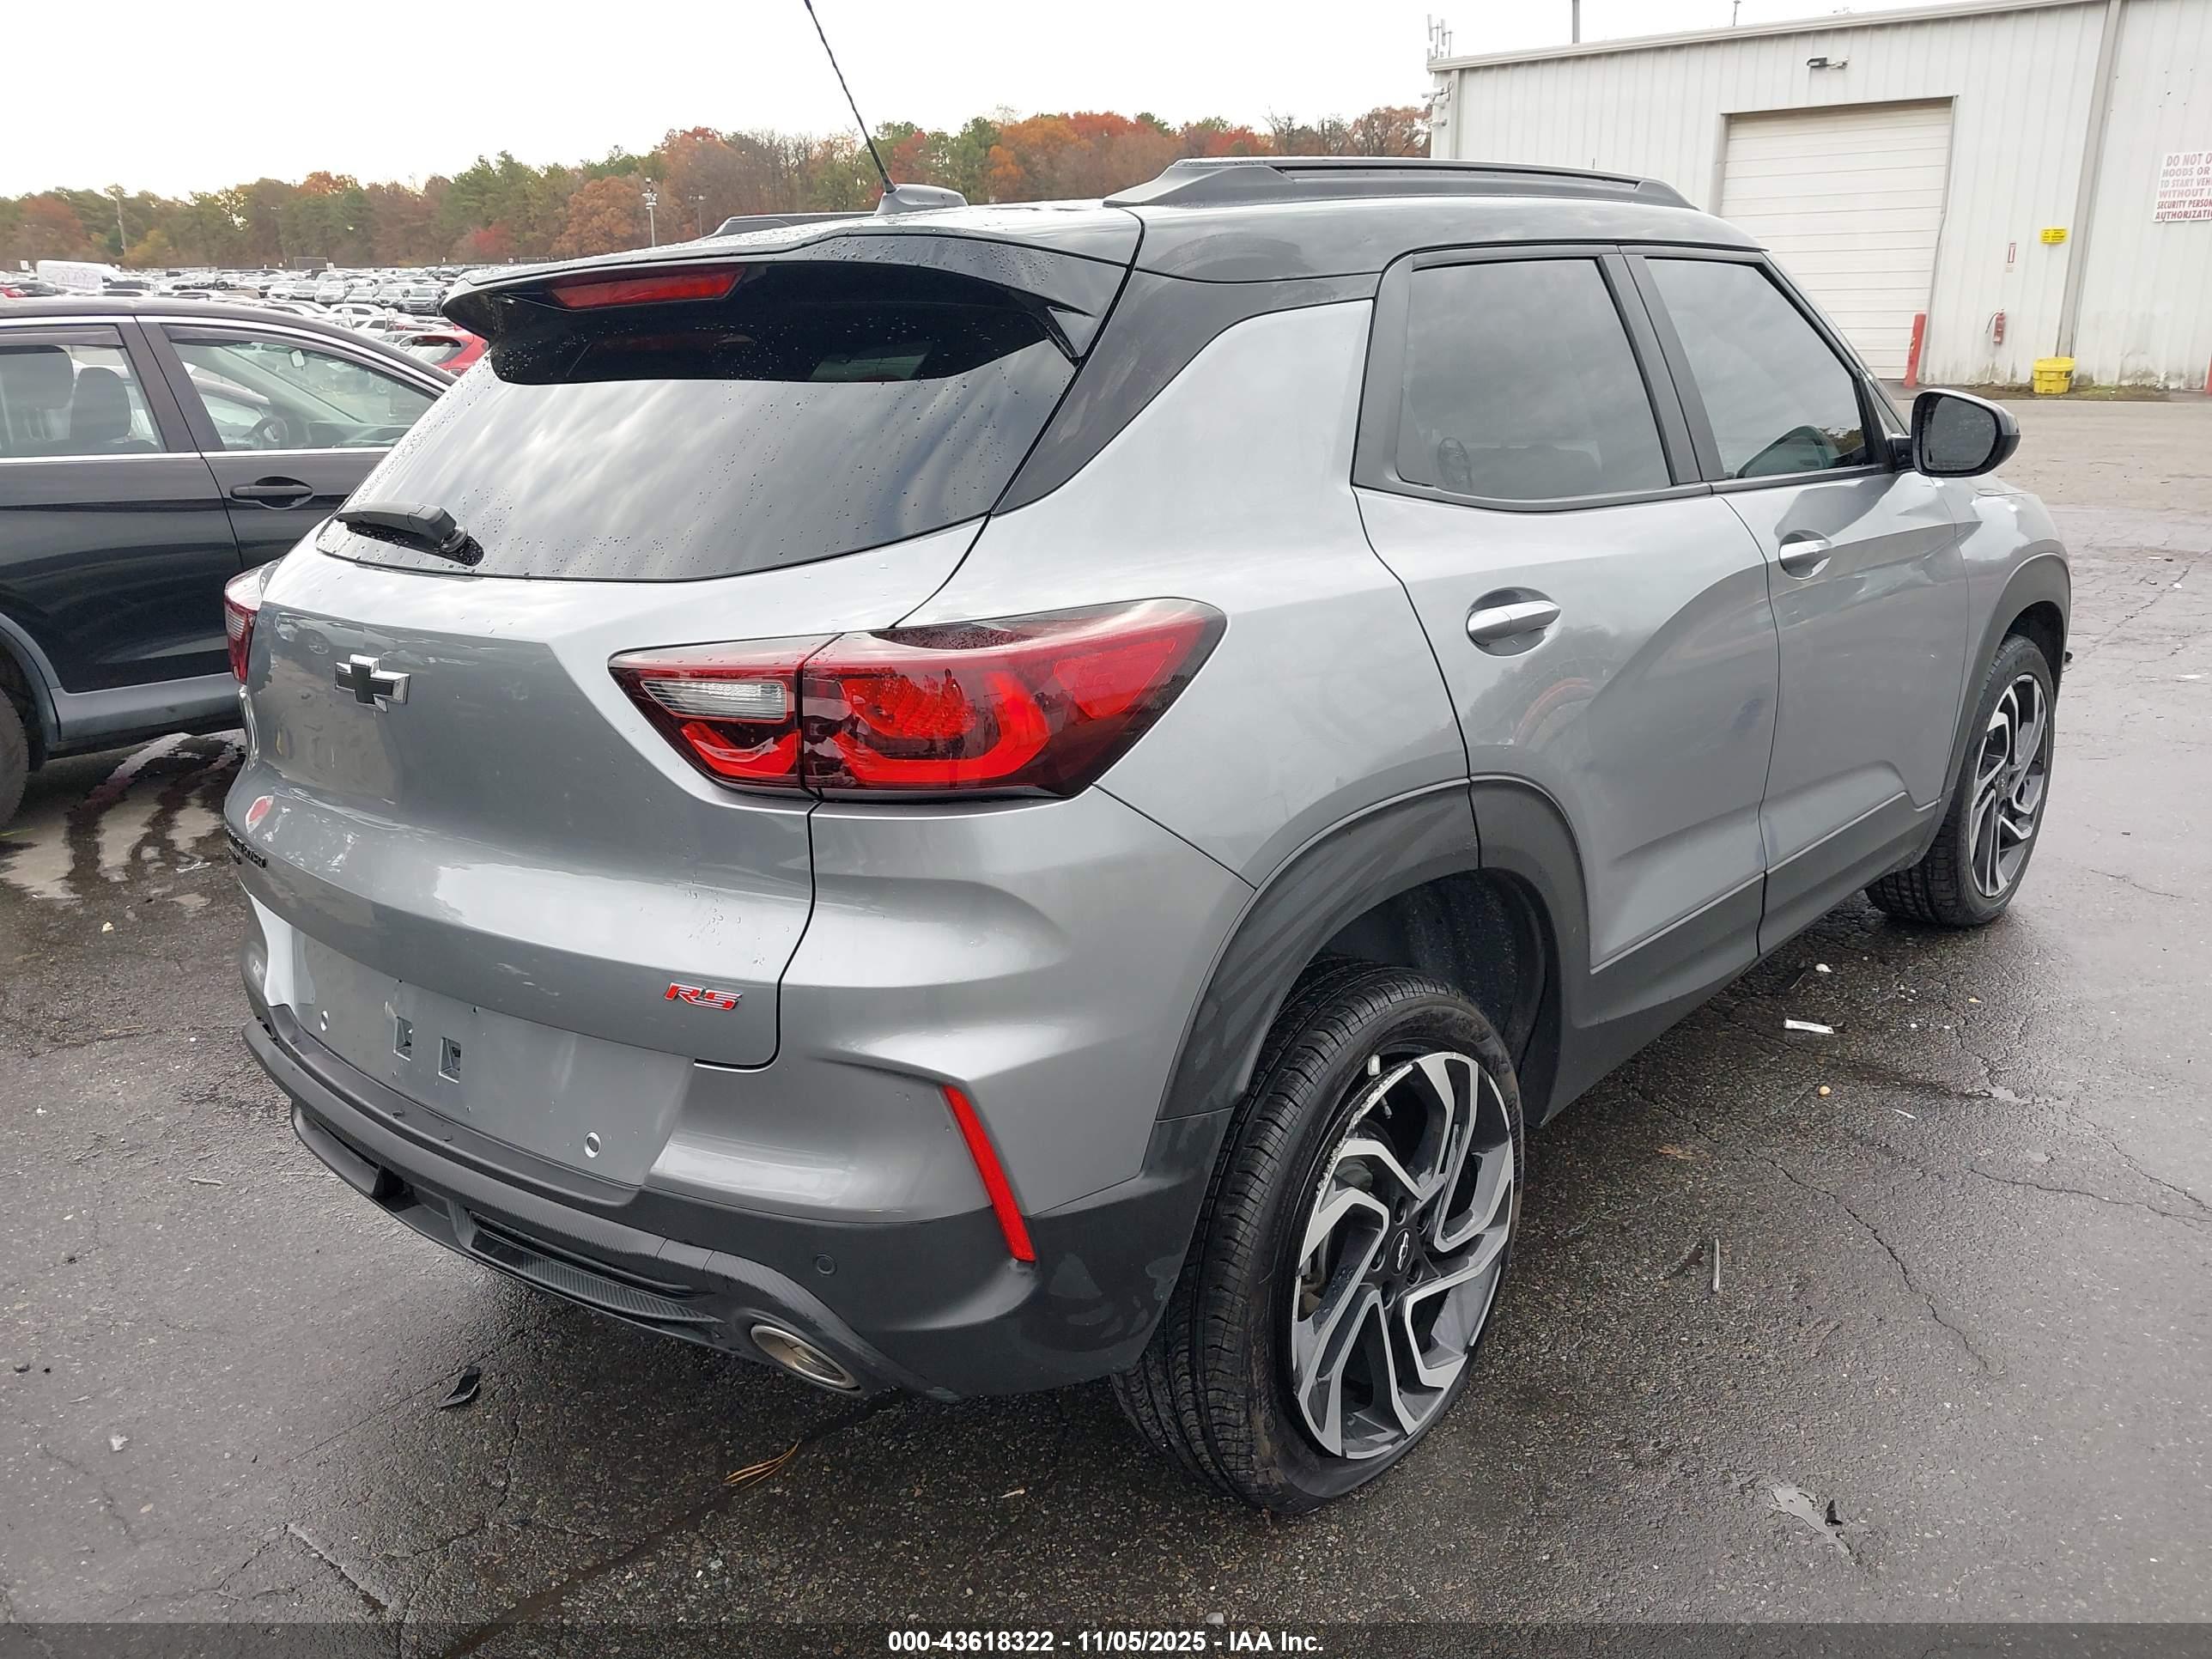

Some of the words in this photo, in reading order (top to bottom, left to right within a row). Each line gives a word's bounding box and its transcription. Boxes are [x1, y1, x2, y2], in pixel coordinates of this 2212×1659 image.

[2166, 155, 2179, 167] DO
[2183, 154, 2203, 166] NOT
[2162, 167, 2193, 177] HOODS
[2197, 167, 2210, 175] OR
[2161, 179, 2169, 188] TO
[2171, 179, 2194, 187] START
[2159, 189, 2205, 198] WITHOUT
[2157, 200, 2186, 210] SECURITY
[665, 982, 742, 1010] RS
